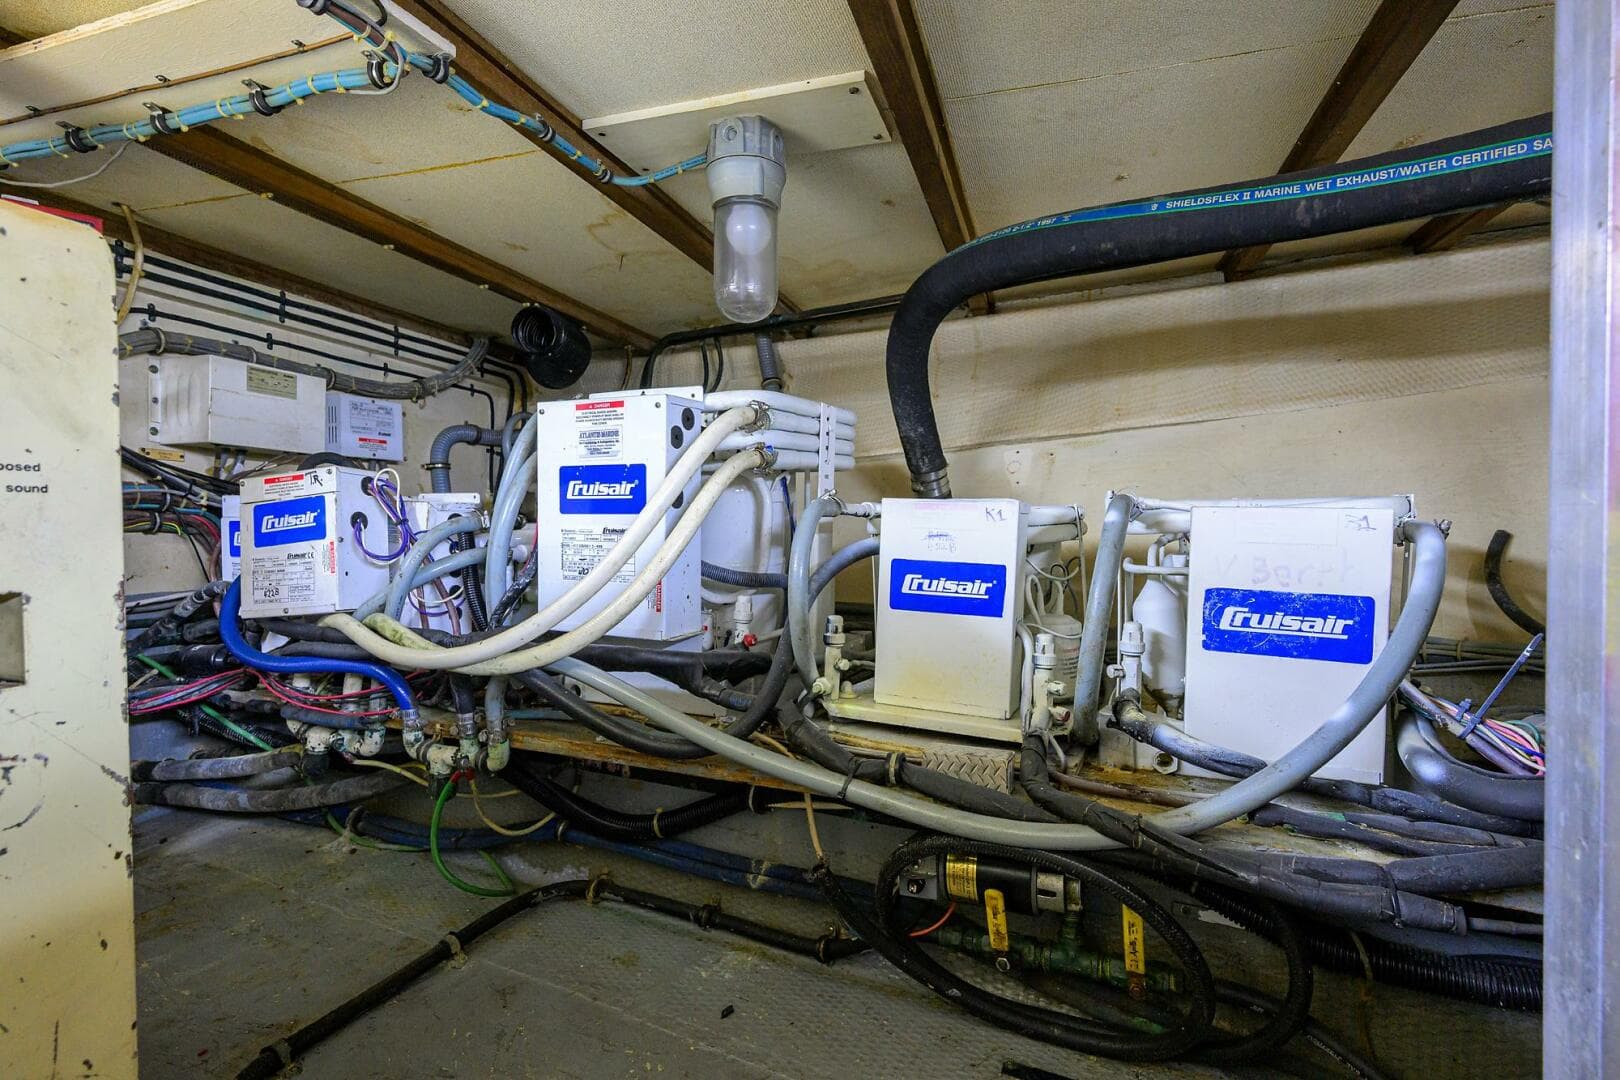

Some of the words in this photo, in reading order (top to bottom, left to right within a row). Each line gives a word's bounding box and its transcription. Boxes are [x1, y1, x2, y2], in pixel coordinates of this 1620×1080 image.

[1166, 193, 1239, 209] SHIELDSFLEX
[1254, 186, 1301, 199] MARINE
[1305, 179, 1333, 192] WET
[1336, 159, 1448, 187] EXHAUST/WATER
[1452, 142, 1528, 166] CERTIFIED
[6, 484, 48, 494] sound
[566, 480, 636, 500] Cruisair
[261, 510, 319, 533] Cruisair
[985, 505, 1008, 522] K1
[901, 574, 993, 599] Cruisair
[1219, 606, 1354, 640] Cruisair
